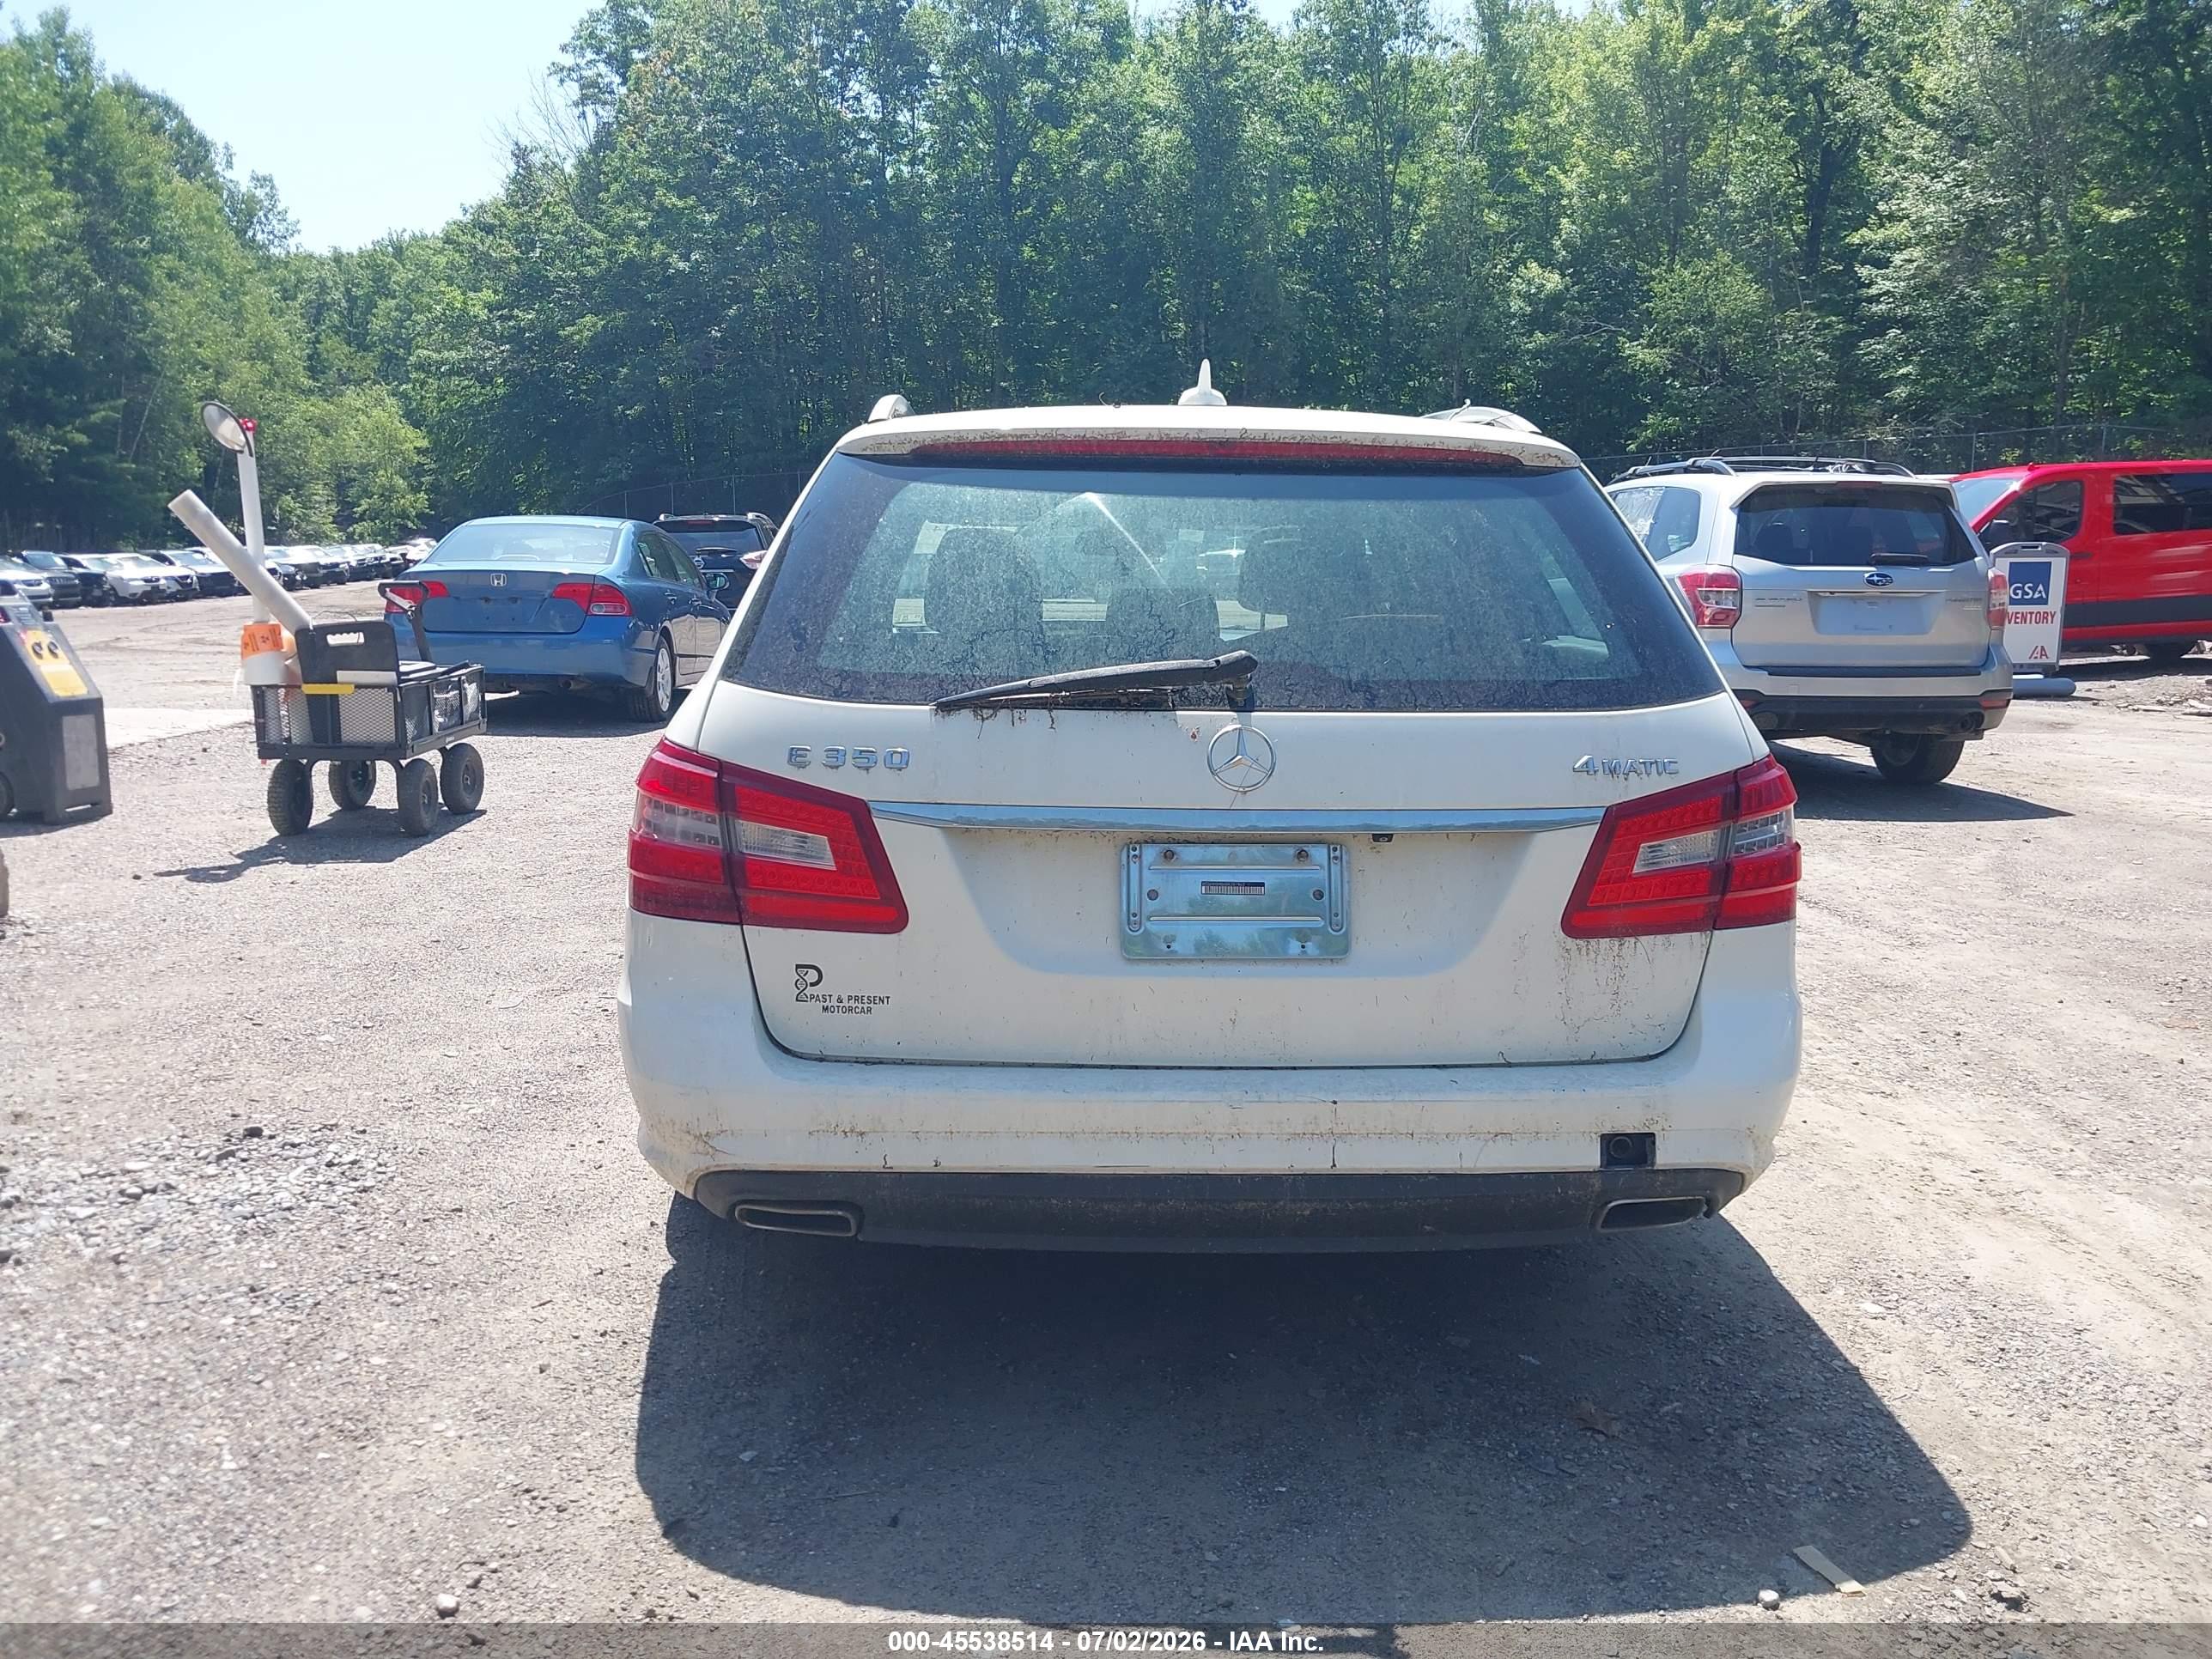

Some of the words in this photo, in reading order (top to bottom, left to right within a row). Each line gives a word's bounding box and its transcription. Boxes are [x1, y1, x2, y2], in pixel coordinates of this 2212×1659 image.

[2010, 583, 2047, 599] GSA
[2007, 611, 2057, 625] VENTORY
[787, 745, 811, 768] E
[822, 745, 910, 769] 350
[809, 994, 833, 1004] PAST
[836, 994, 844, 1004] &
[848, 995, 890, 1006] PRESENT
[822, 1005, 872, 1015] MOTORCAR
